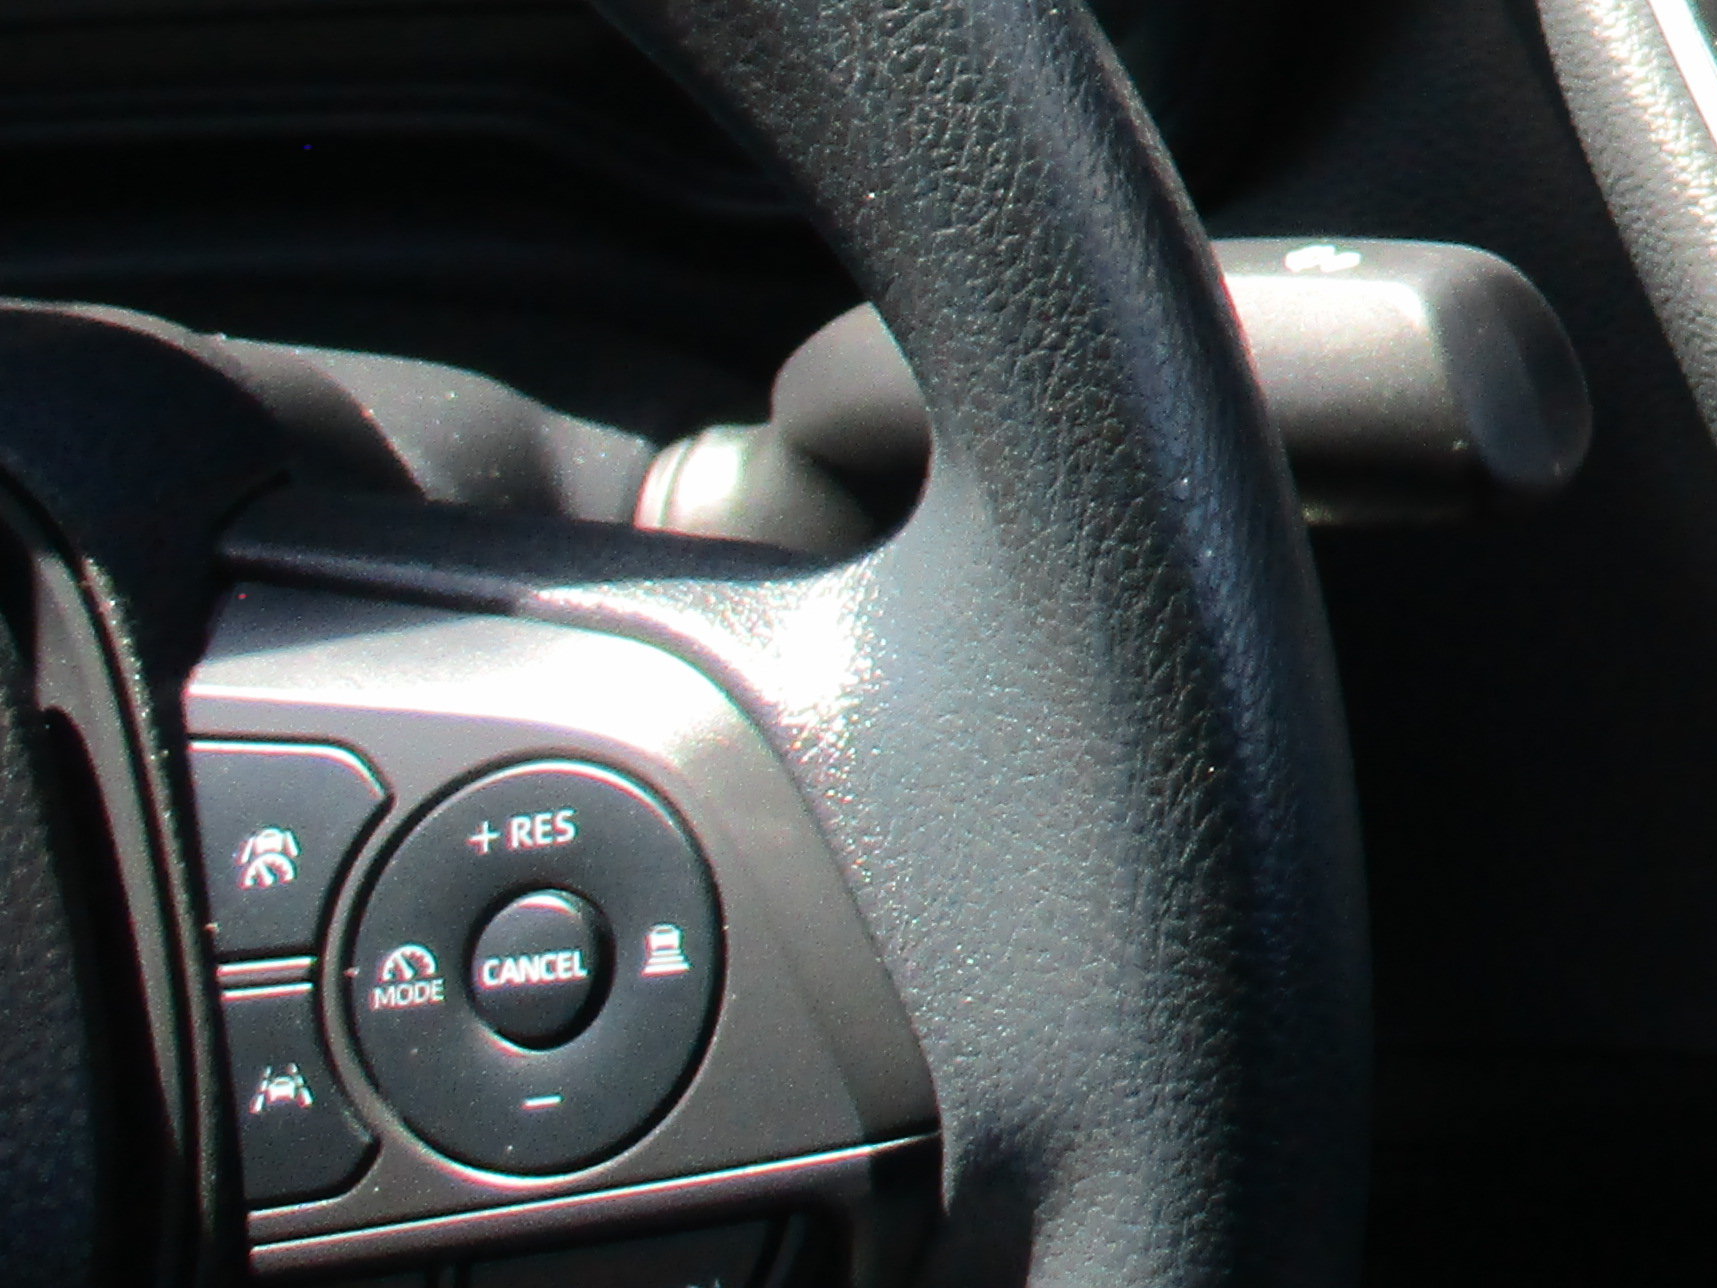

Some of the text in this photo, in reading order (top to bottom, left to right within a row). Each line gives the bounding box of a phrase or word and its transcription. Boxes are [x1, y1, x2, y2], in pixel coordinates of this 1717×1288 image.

[510, 810, 575, 848] RES
[481, 951, 586, 987] CANCEL
[373, 980, 445, 1010] MODE
